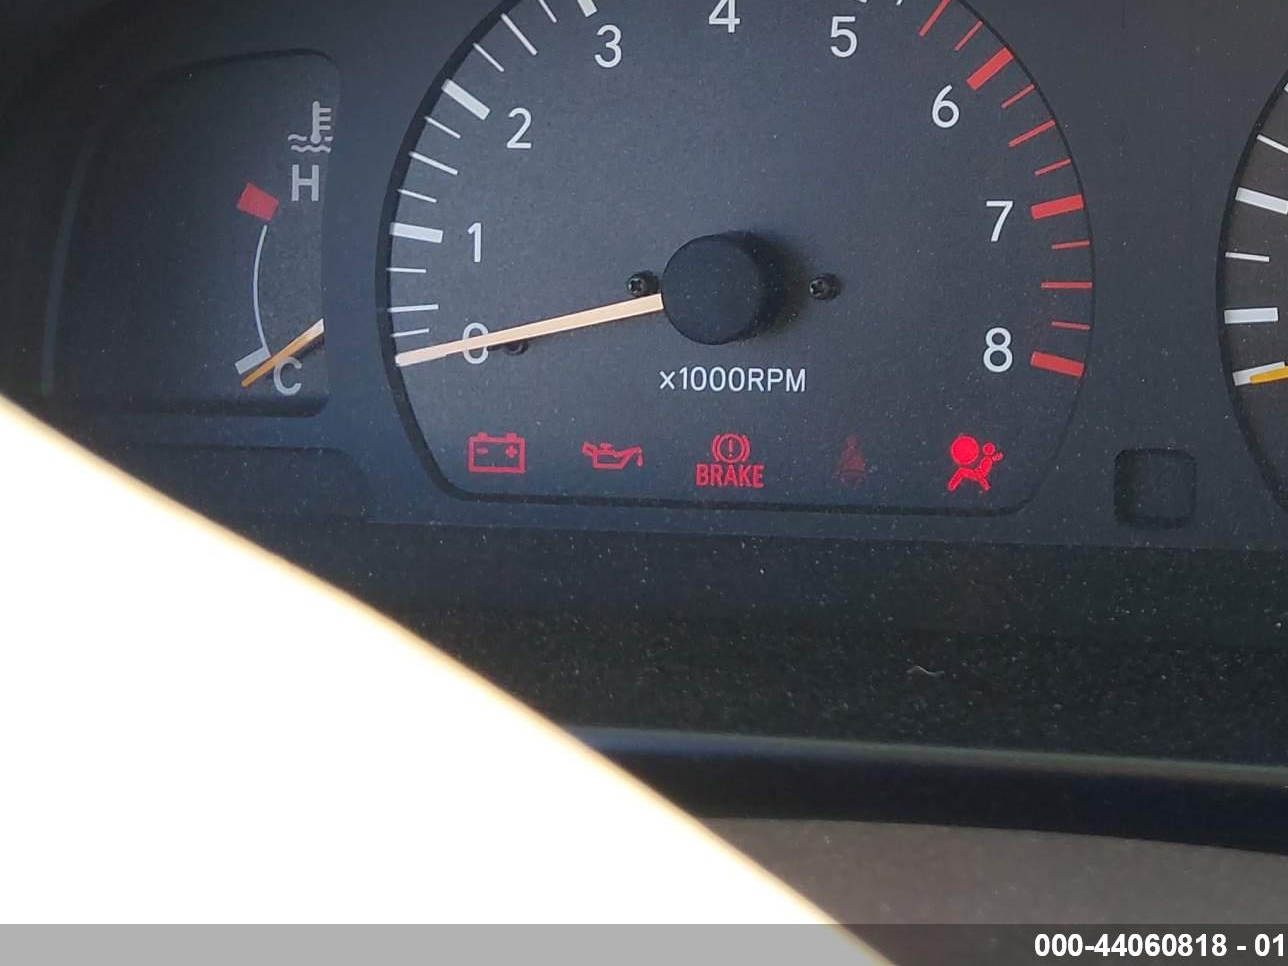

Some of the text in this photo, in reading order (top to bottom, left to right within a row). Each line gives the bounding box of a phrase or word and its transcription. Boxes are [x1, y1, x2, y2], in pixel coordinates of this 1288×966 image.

[595, 25, 622, 68] 3
[830, 16, 858, 58] 5
[933, 85, 959, 128] 6
[507, 109, 532, 149] 2
[291, 164, 319, 201] H
[986, 201, 1013, 241] 7
[468, 222, 482, 262] 1
[984, 328, 1012, 372] 8
[273, 358, 301, 395] C
[696, 464, 764, 488] BRAKE
